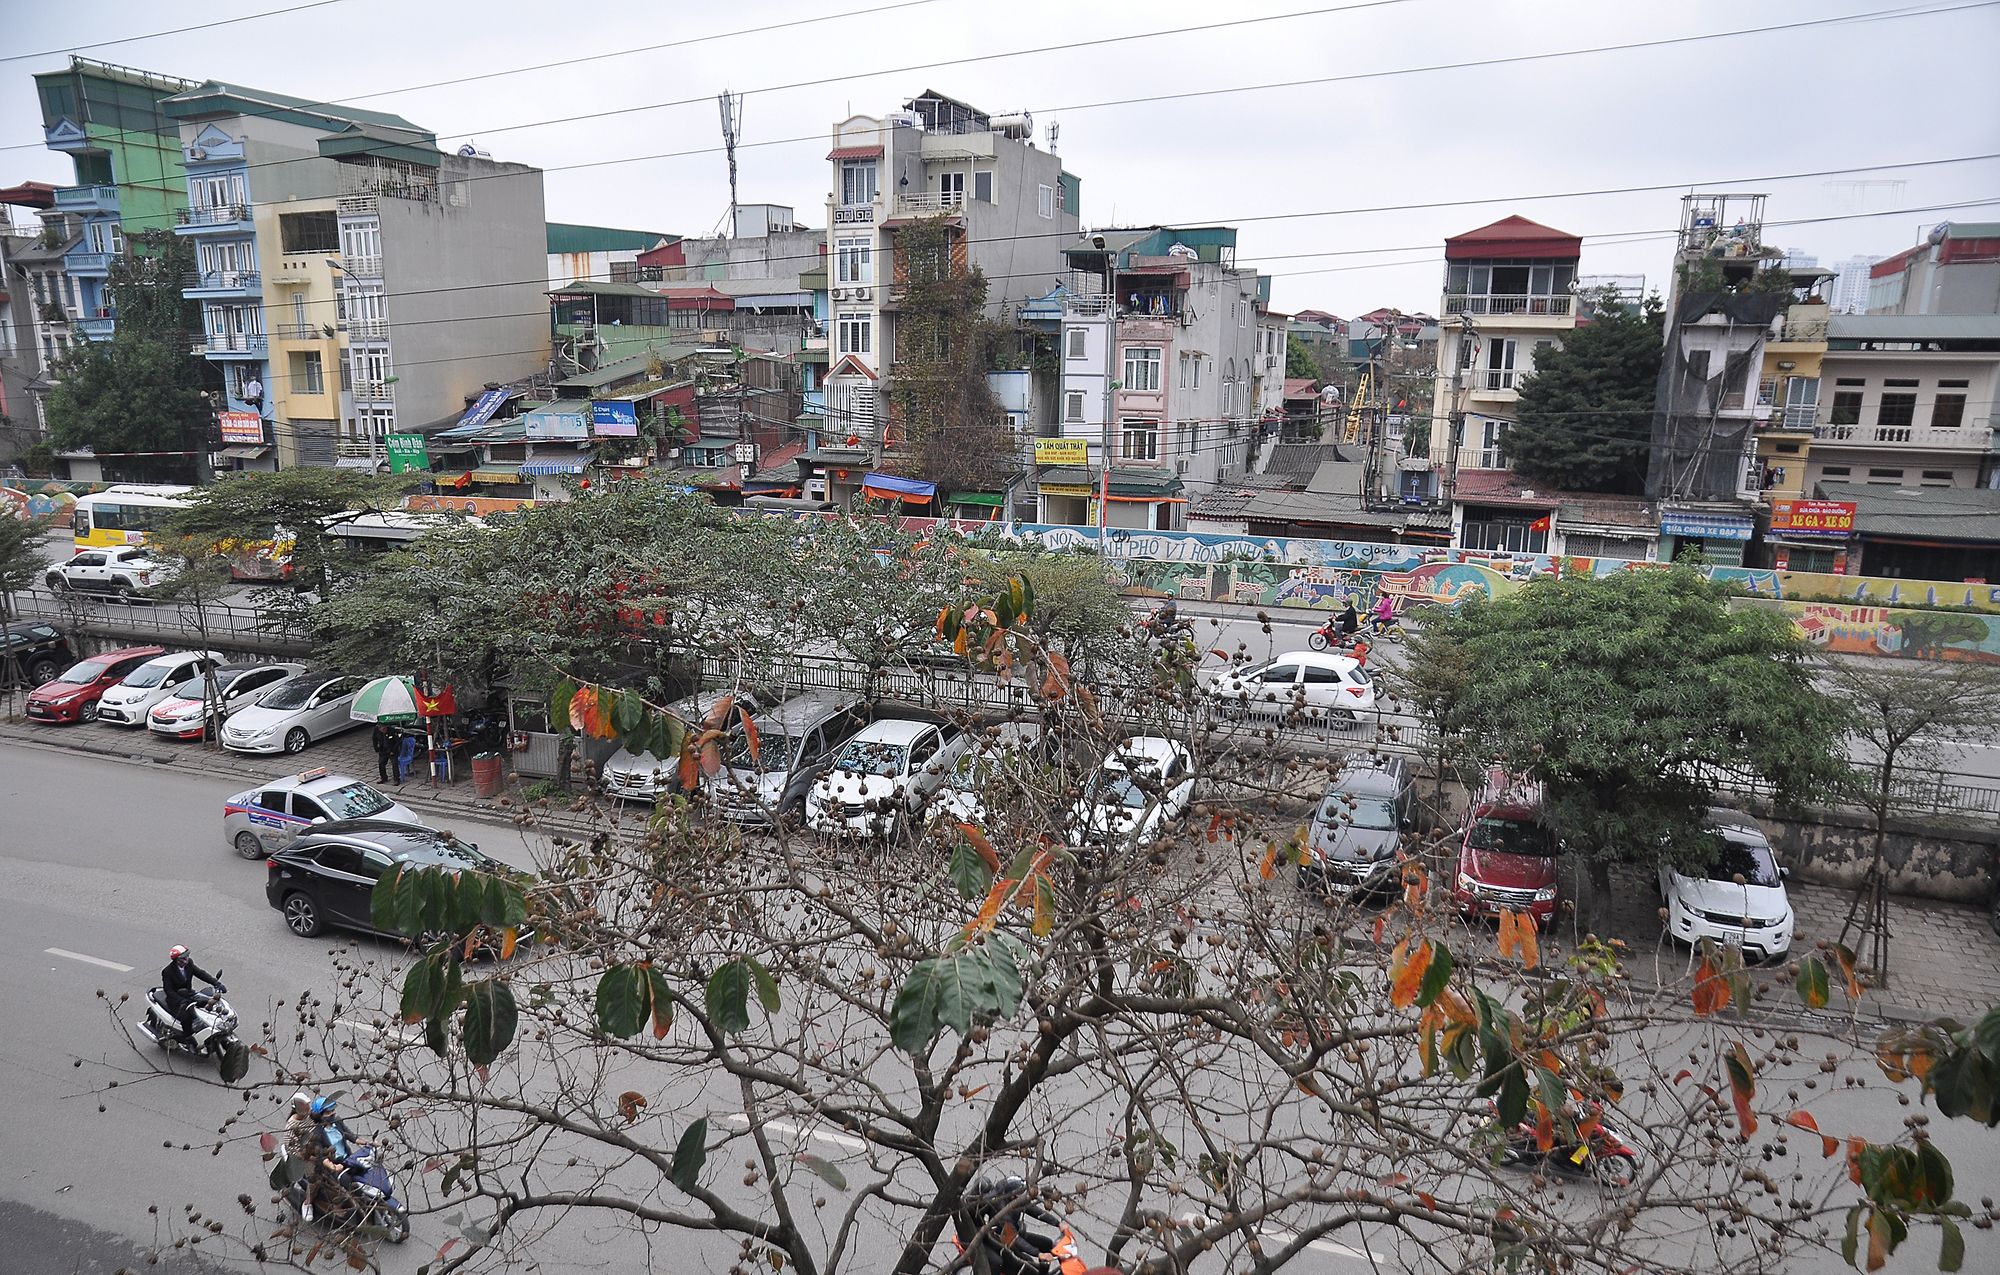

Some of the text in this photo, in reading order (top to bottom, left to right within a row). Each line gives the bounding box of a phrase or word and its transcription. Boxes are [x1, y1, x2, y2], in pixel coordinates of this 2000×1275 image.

[1791, 514, 1804, 526] XE
[1805, 515, 1818, 527] GA
[1824, 516, 1838, 528] XE
[1838, 511, 1852, 528] SỐ
